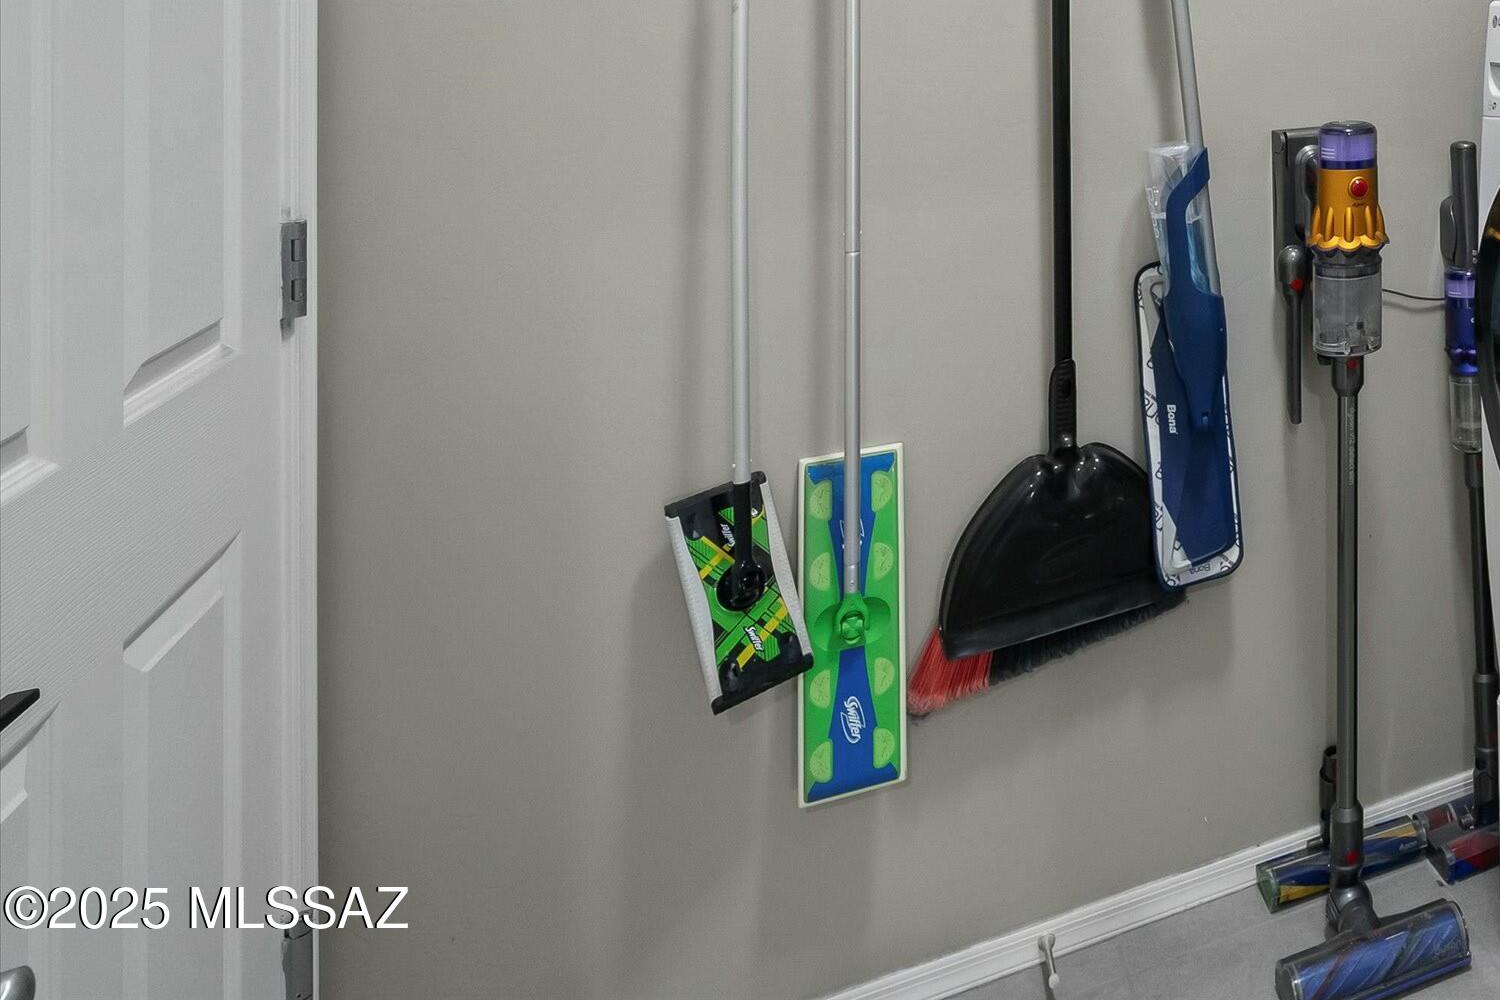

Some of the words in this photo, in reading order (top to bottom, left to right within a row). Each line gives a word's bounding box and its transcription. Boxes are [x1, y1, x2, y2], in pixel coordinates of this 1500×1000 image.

[1166, 404, 1177, 434] Bona
[1189, 563, 1211, 575] Bona
[744, 626, 764, 651] Swiffer
[843, 700, 862, 740] Swiffer
